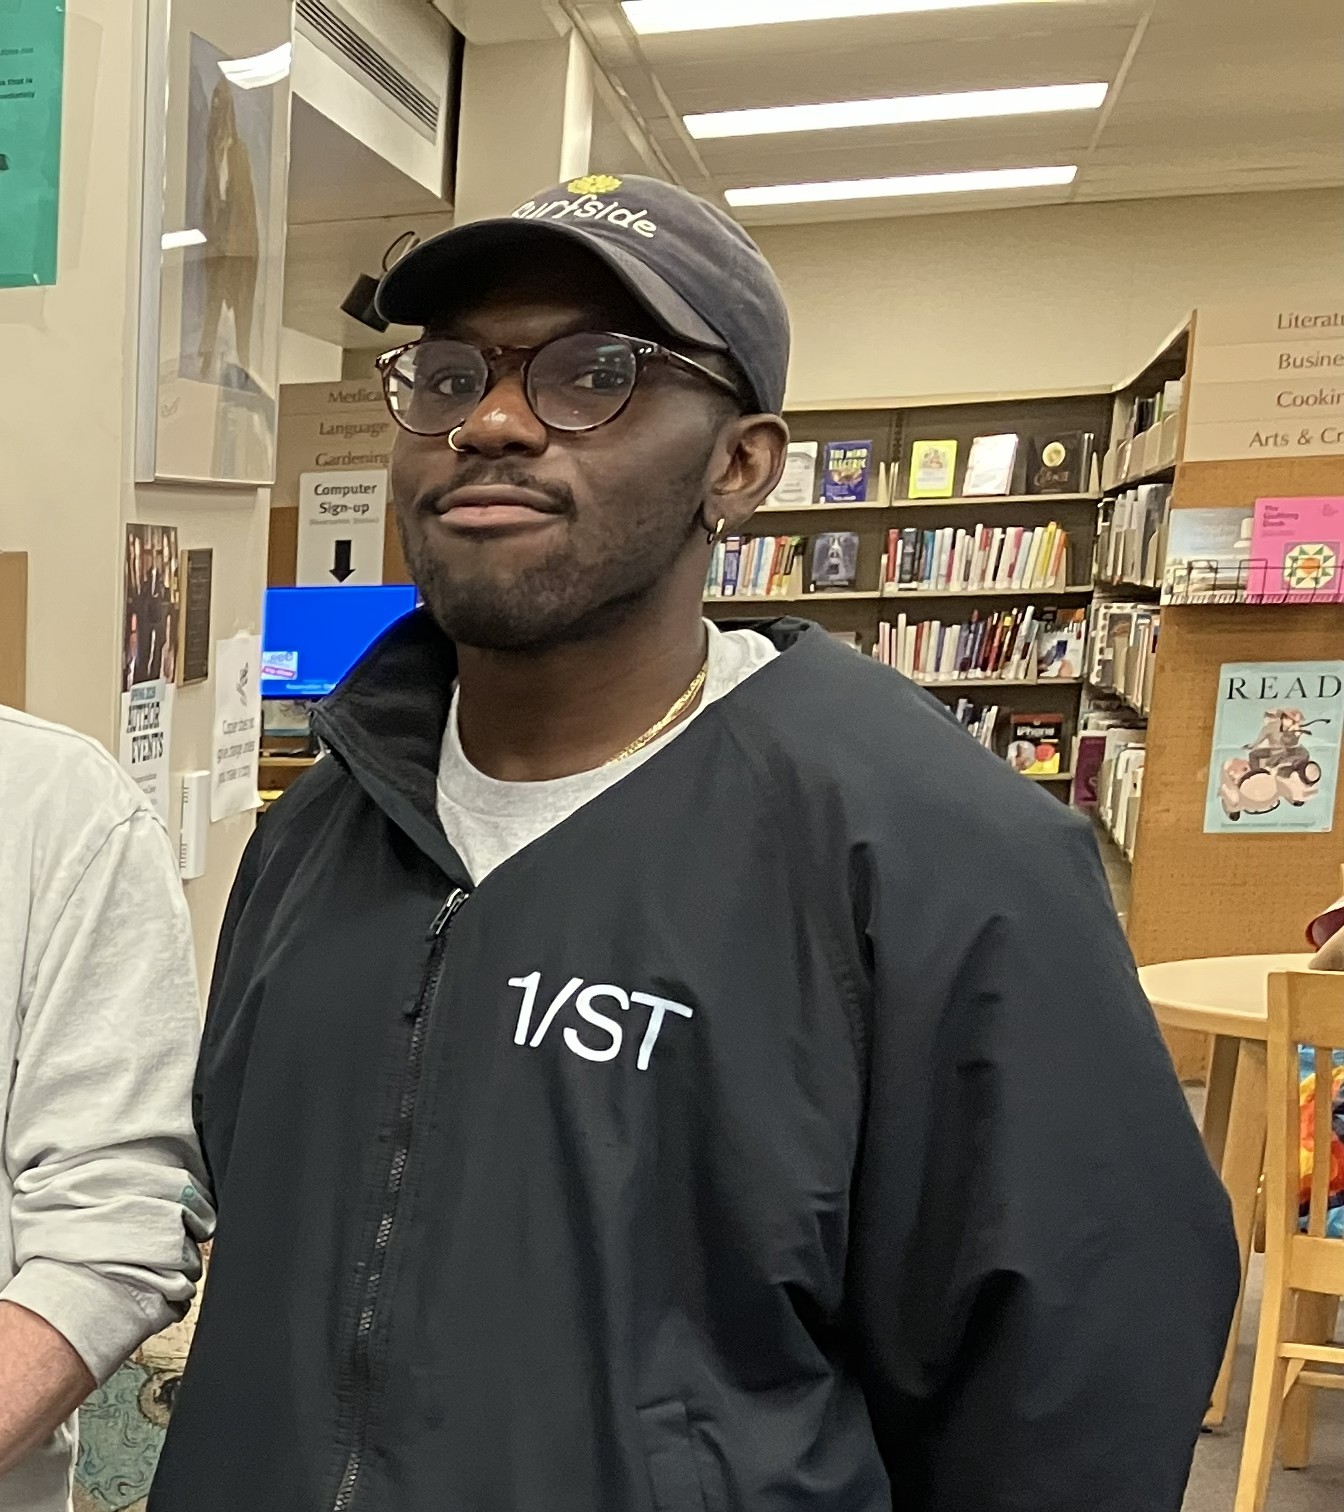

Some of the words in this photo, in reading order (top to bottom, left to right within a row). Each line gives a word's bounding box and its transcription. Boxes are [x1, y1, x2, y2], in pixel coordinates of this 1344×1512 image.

[319, 421, 389, 439] Language
[1249, 430, 1289, 447] Arts
[1297, 428, 1312, 446] &
[314, 483, 377, 498] Computer
[318, 501, 370, 516] Sign-up
[1226, 673, 1342, 700] READ
[508, 971, 693, 1071] 1/ST
